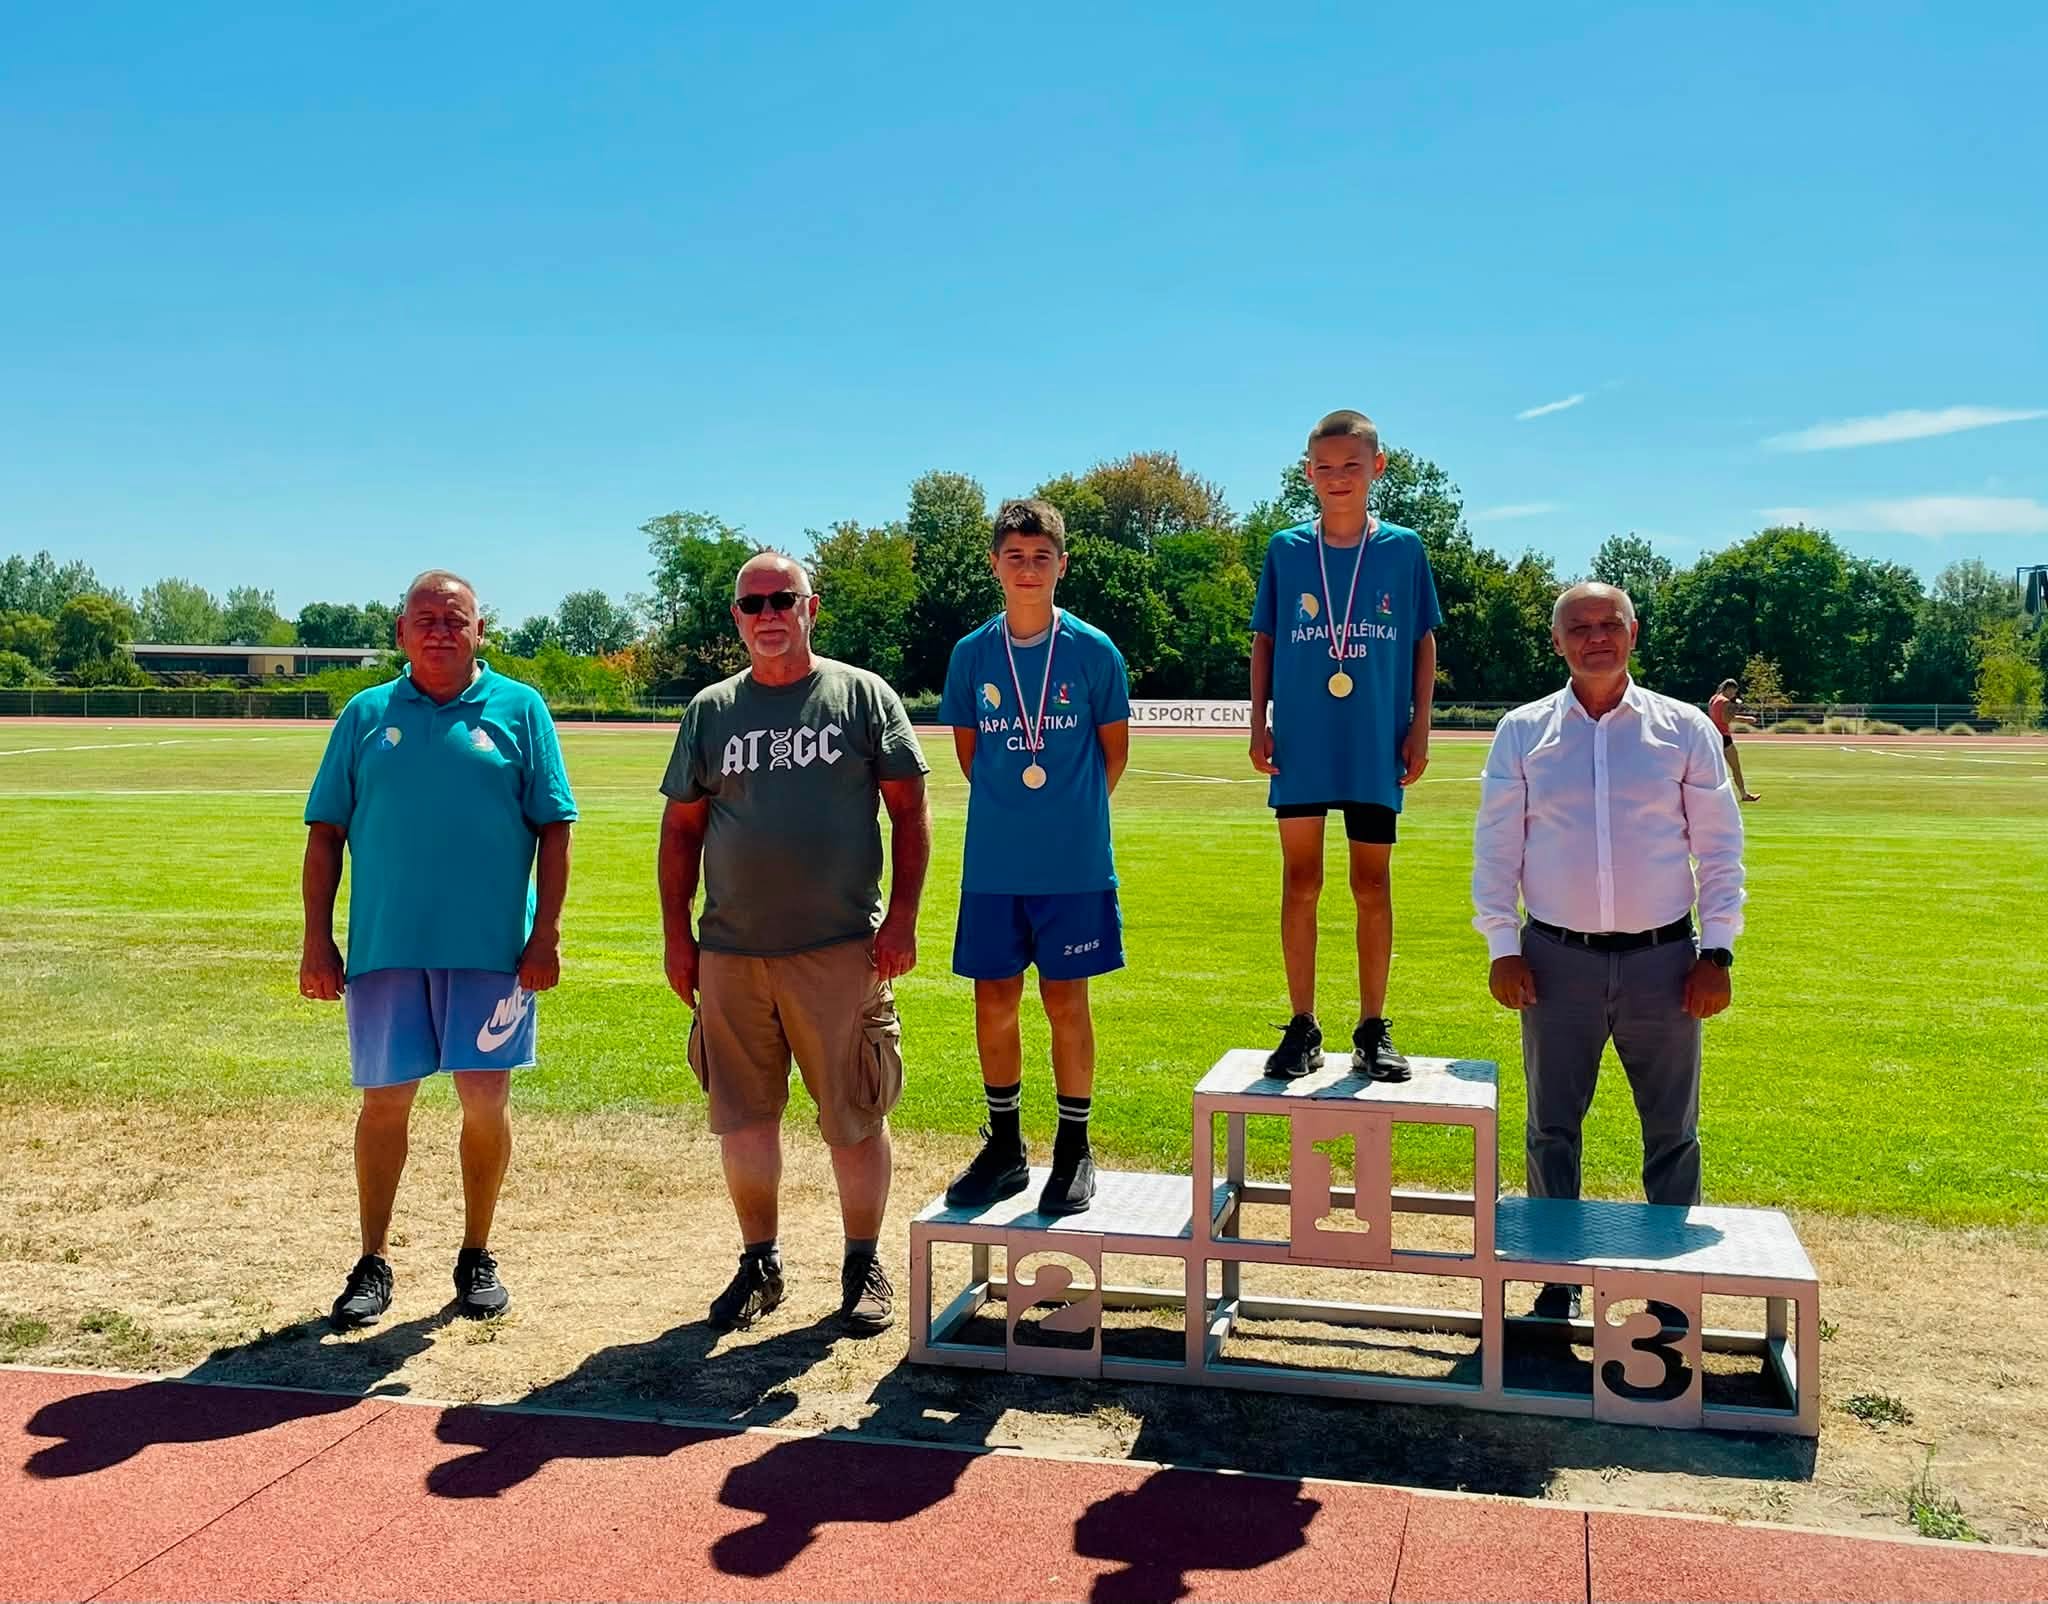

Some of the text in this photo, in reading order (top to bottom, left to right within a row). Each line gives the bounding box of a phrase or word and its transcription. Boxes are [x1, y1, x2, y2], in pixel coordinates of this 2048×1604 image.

[1291, 623, 1328, 643] PÁPAI
[1148, 707, 1205, 721] SPORT
[1312, 1132, 1371, 1234] 1
[1013, 1250, 1097, 1351] 2
[1601, 1298, 1693, 1402] 3
